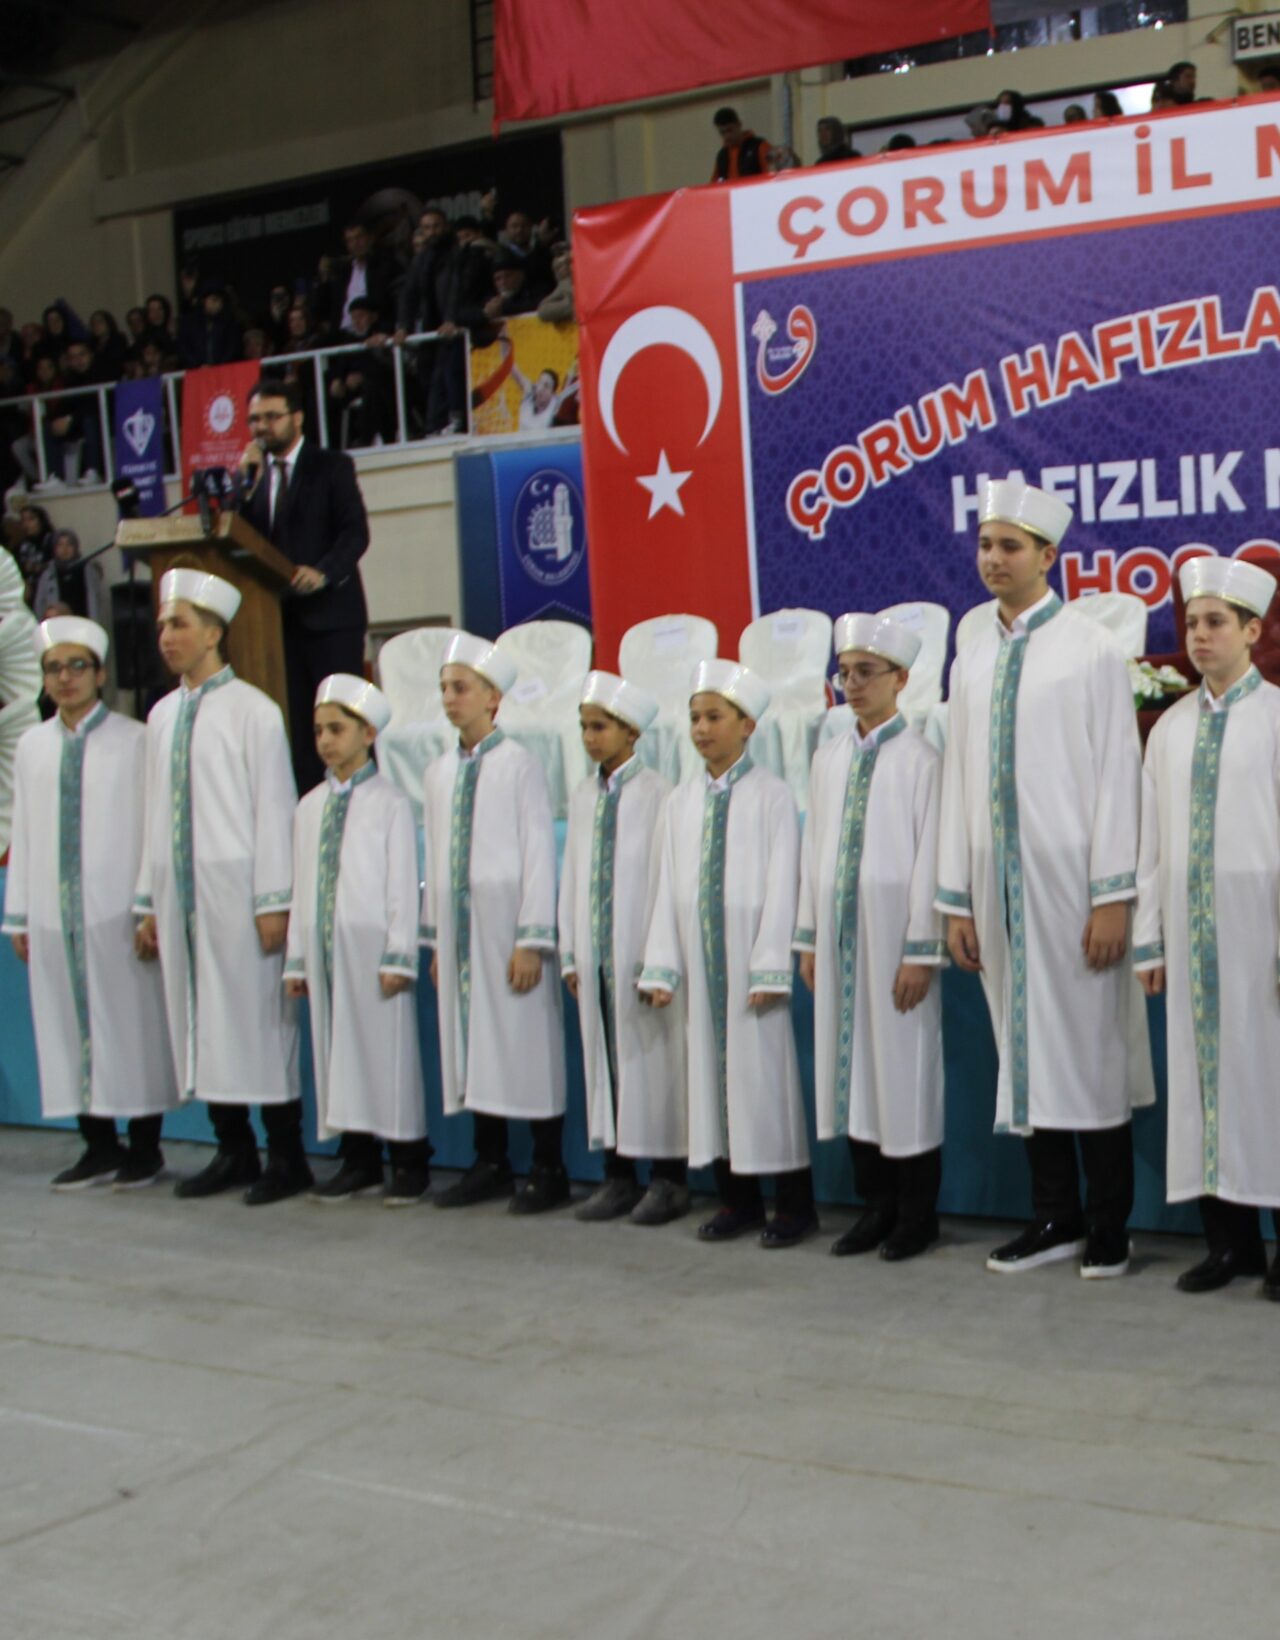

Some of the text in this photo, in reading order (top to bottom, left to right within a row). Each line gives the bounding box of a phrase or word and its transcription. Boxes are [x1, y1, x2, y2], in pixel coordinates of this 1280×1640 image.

[778, 152, 1093, 258] ÇORUM
[1135, 125, 1213, 195] İL
[786, 369, 996, 538] ÇORUM
[952, 450, 1246, 533] HFIZLIK
